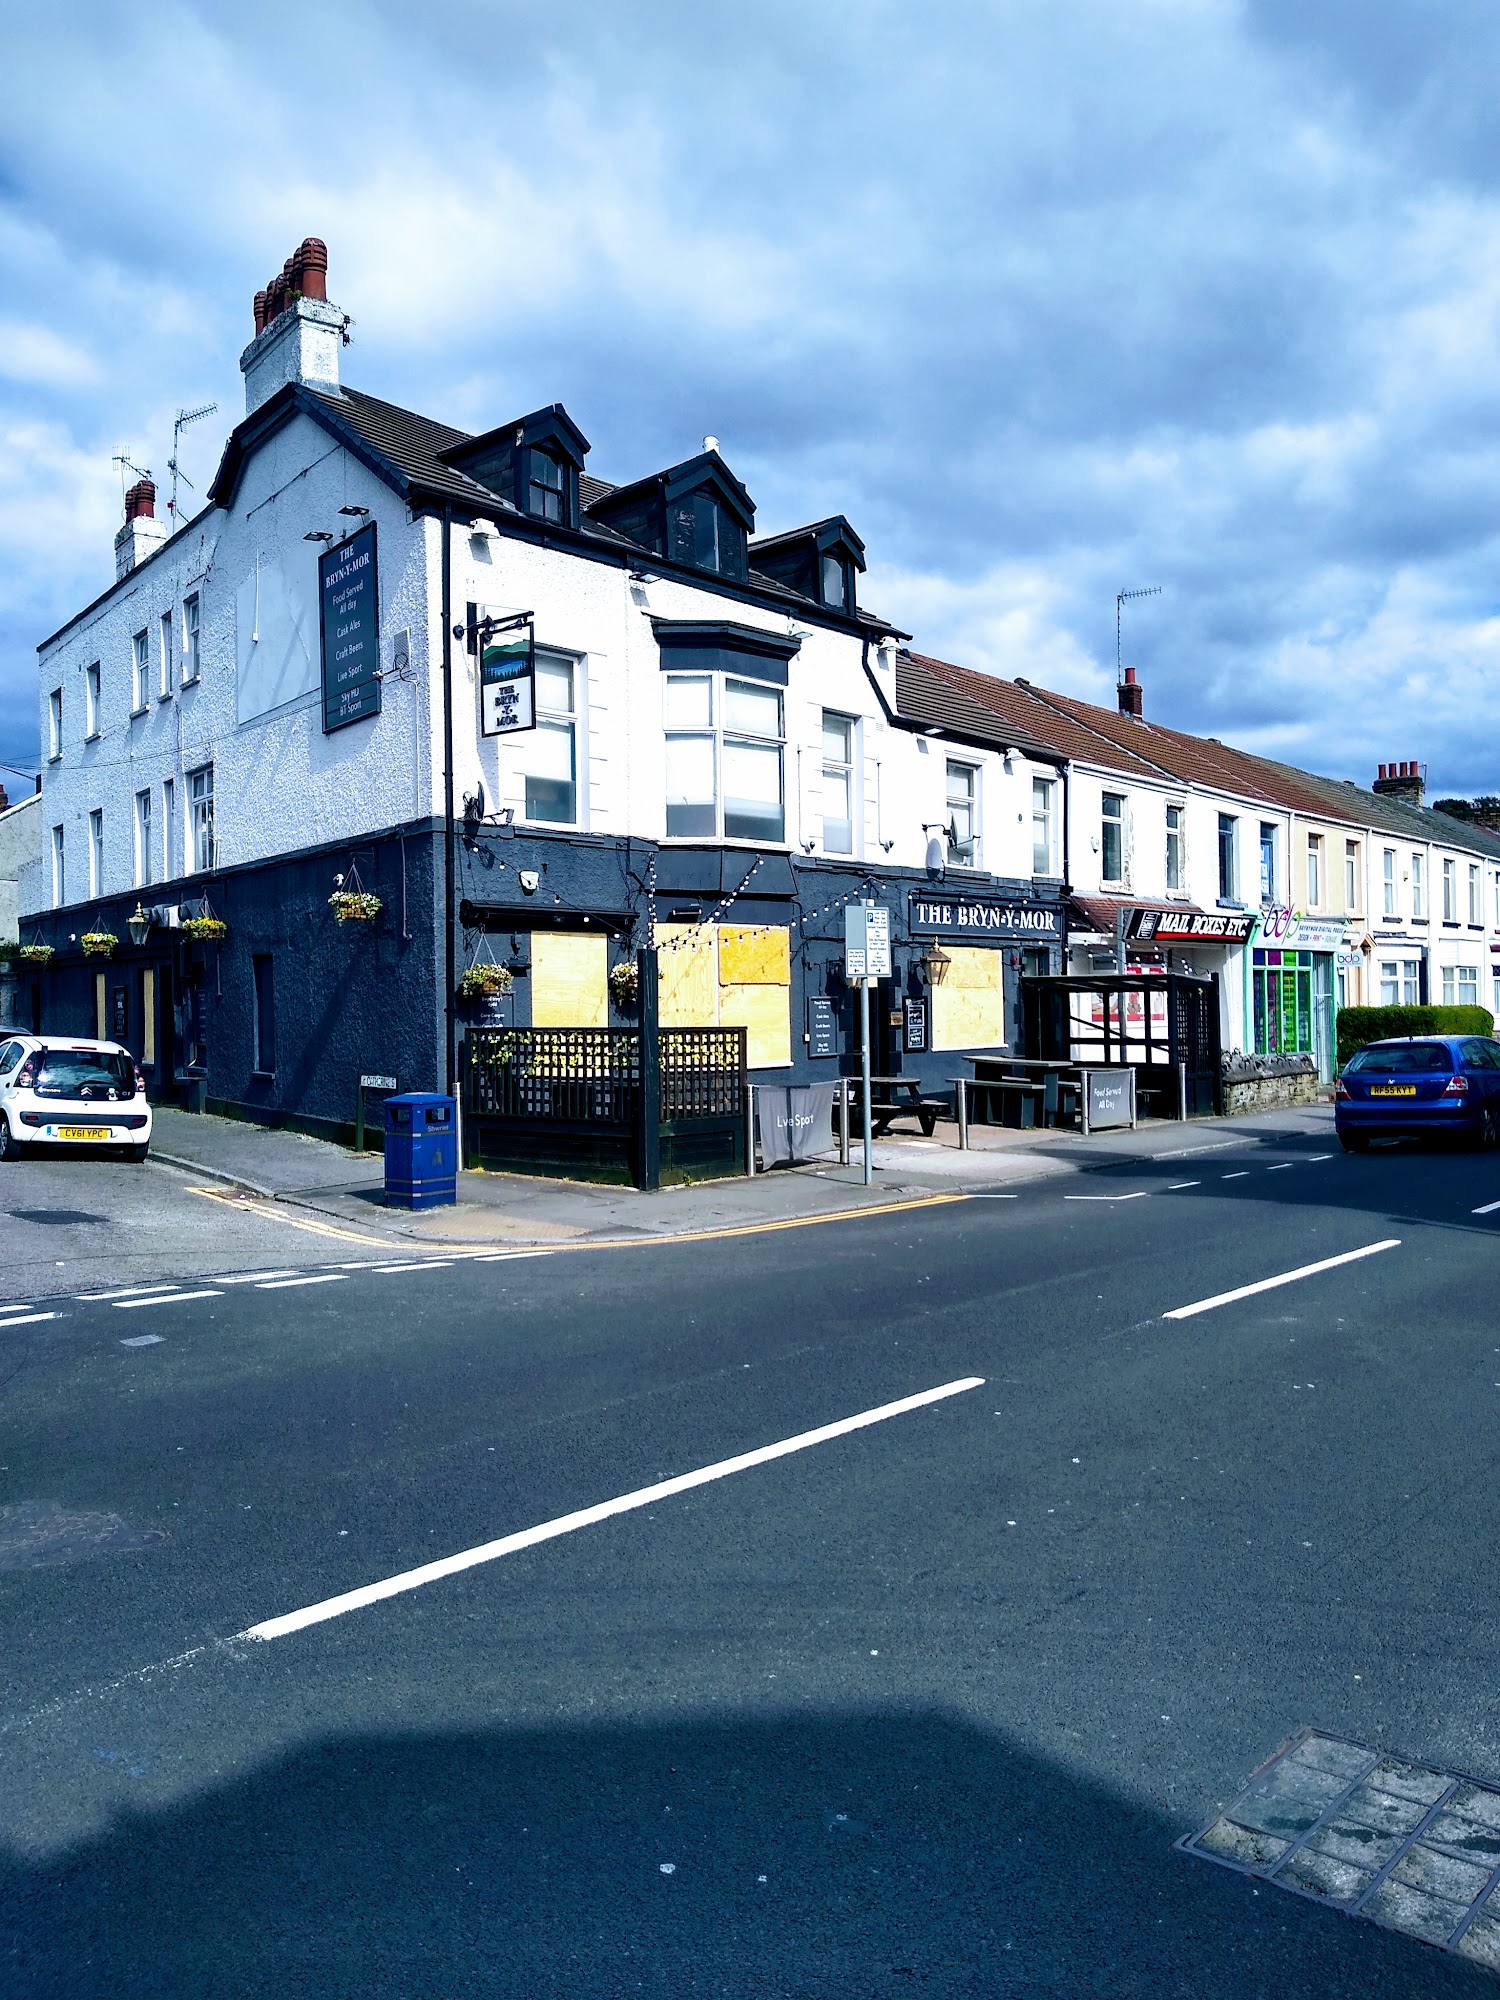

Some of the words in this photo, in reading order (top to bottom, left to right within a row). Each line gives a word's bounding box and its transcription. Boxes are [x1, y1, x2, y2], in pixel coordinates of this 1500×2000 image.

[340, 544, 354, 562] THE
[332, 589, 346, 606] Food
[346, 579, 364, 598] Served
[347, 599, 357, 611] day
[336, 624, 349, 638] Cask
[349, 619, 361, 632] Ales
[335, 646, 349, 661] Craft
[349, 641, 364, 656] Beers
[337, 670, 348, 683] Live
[348, 663, 363, 678] Sport
[341, 691, 350, 703] Sky
[499, 685, 515, 696] THE
[347, 700, 362, 713] Sport
[494, 693, 520, 707] BRYN
[916, 902, 952, 925] THE
[1157, 912, 1190, 933] MAIL
[1190, 915, 1227, 936] BOXES
[1094, 1087, 1106, 1097] Food
[1106, 1085, 1122, 1096] Served
[1374, 1086, 1394, 1094] RF55
[1396, 1086, 1412, 1094] KYT
[1098, 1099, 1106, 1109] All
[1105, 1099, 1115, 1110] Day
[65, 1129, 85, 1138] CV61
[87, 1129, 103, 1138] YPC
